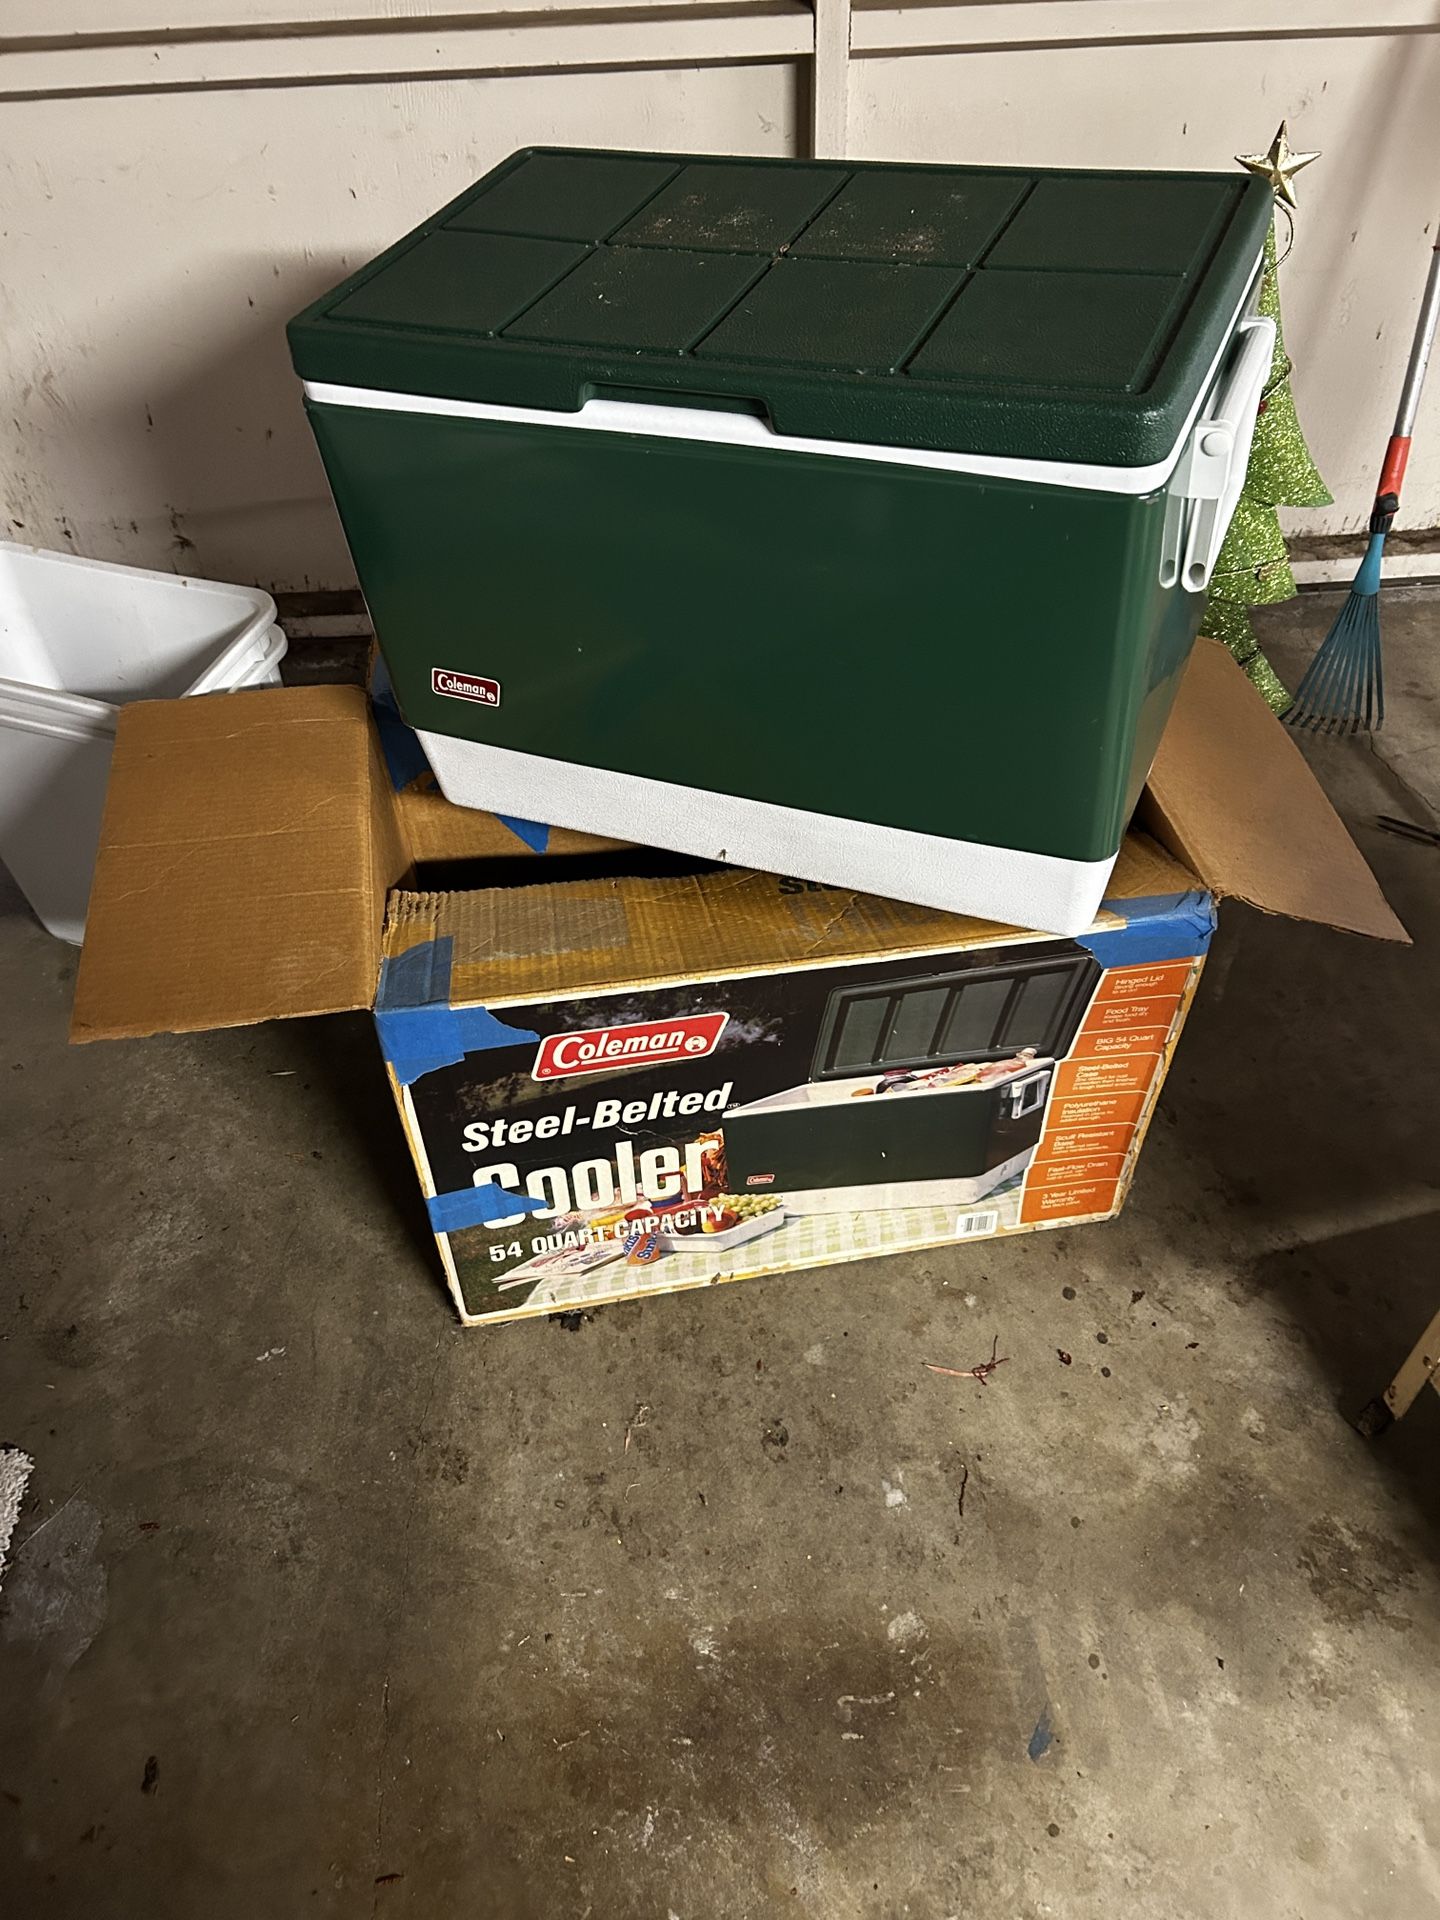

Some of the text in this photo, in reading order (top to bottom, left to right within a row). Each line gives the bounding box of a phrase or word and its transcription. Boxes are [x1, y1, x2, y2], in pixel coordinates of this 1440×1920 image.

[438, 673, 486, 695] Coleman
[1115, 974, 1165, 986] Hinged Lid
[1105, 1007, 1129, 1015] Food
[1096, 1037, 1114, 1045] BIG
[1129, 1034, 1155, 1042] Quart
[552, 1030, 685, 1069] Coleman
[1094, 1043, 1132, 1052] Capacity
[461, 1081, 733, 1153] Steel-Belted
[472, 1138, 719, 1230] Cooler
[1049, 1191, 1067, 1199] Year
[1068, 1187, 1096, 1196] Limited
[1041, 1196, 1076, 1205] Warranty
[489, 1241, 523, 1262] 54
[531, 1225, 607, 1255] QUART
[614, 1203, 725, 1239] CAPACITY
